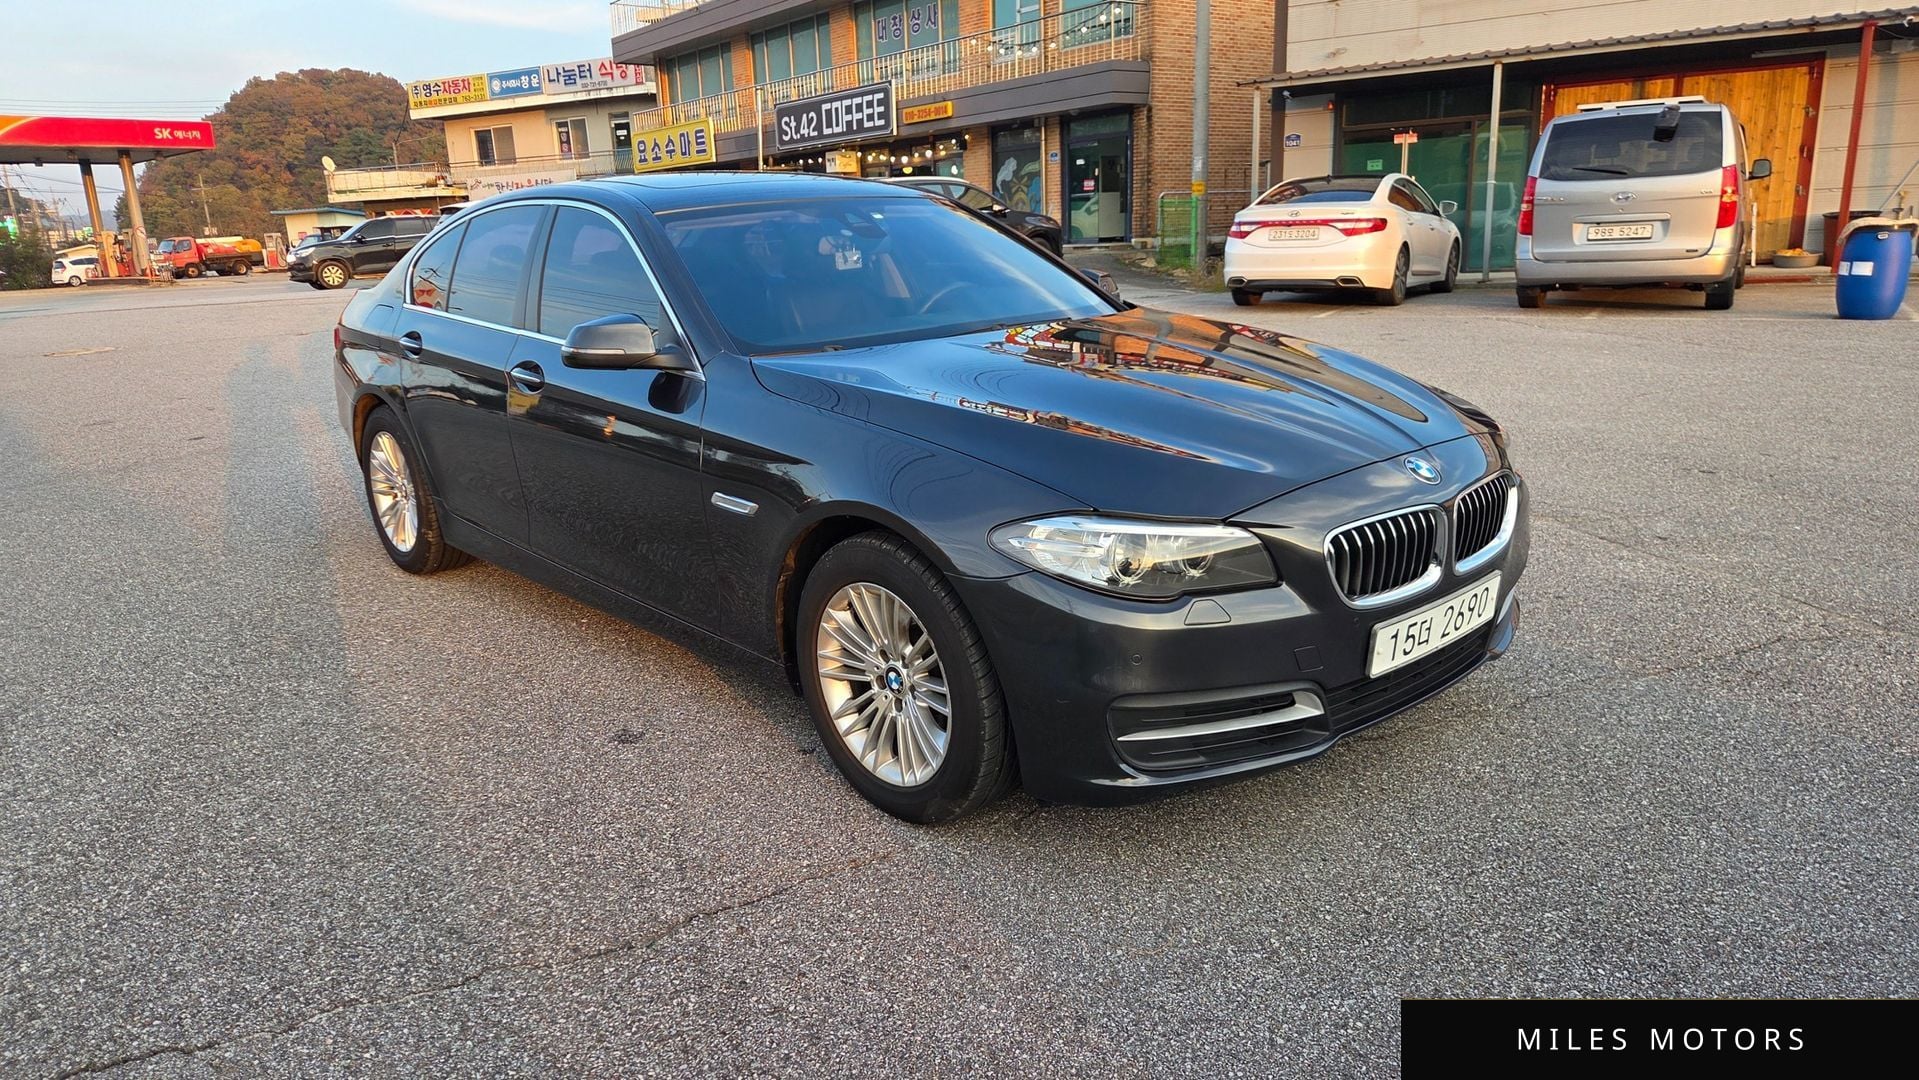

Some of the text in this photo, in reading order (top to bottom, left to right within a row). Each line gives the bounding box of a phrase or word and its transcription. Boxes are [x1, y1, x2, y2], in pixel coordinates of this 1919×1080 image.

[877, 3, 939, 41] 대창상사
[547, 63, 593, 86] 나눔터
[154, 128, 201, 139] SK 에너지
[781, 92, 885, 141] St.42 COFFEE
[637, 128, 707, 163] 요소수마트
[1619, 226, 1646, 237] 5247
[1440, 586, 1489, 640] 2690
